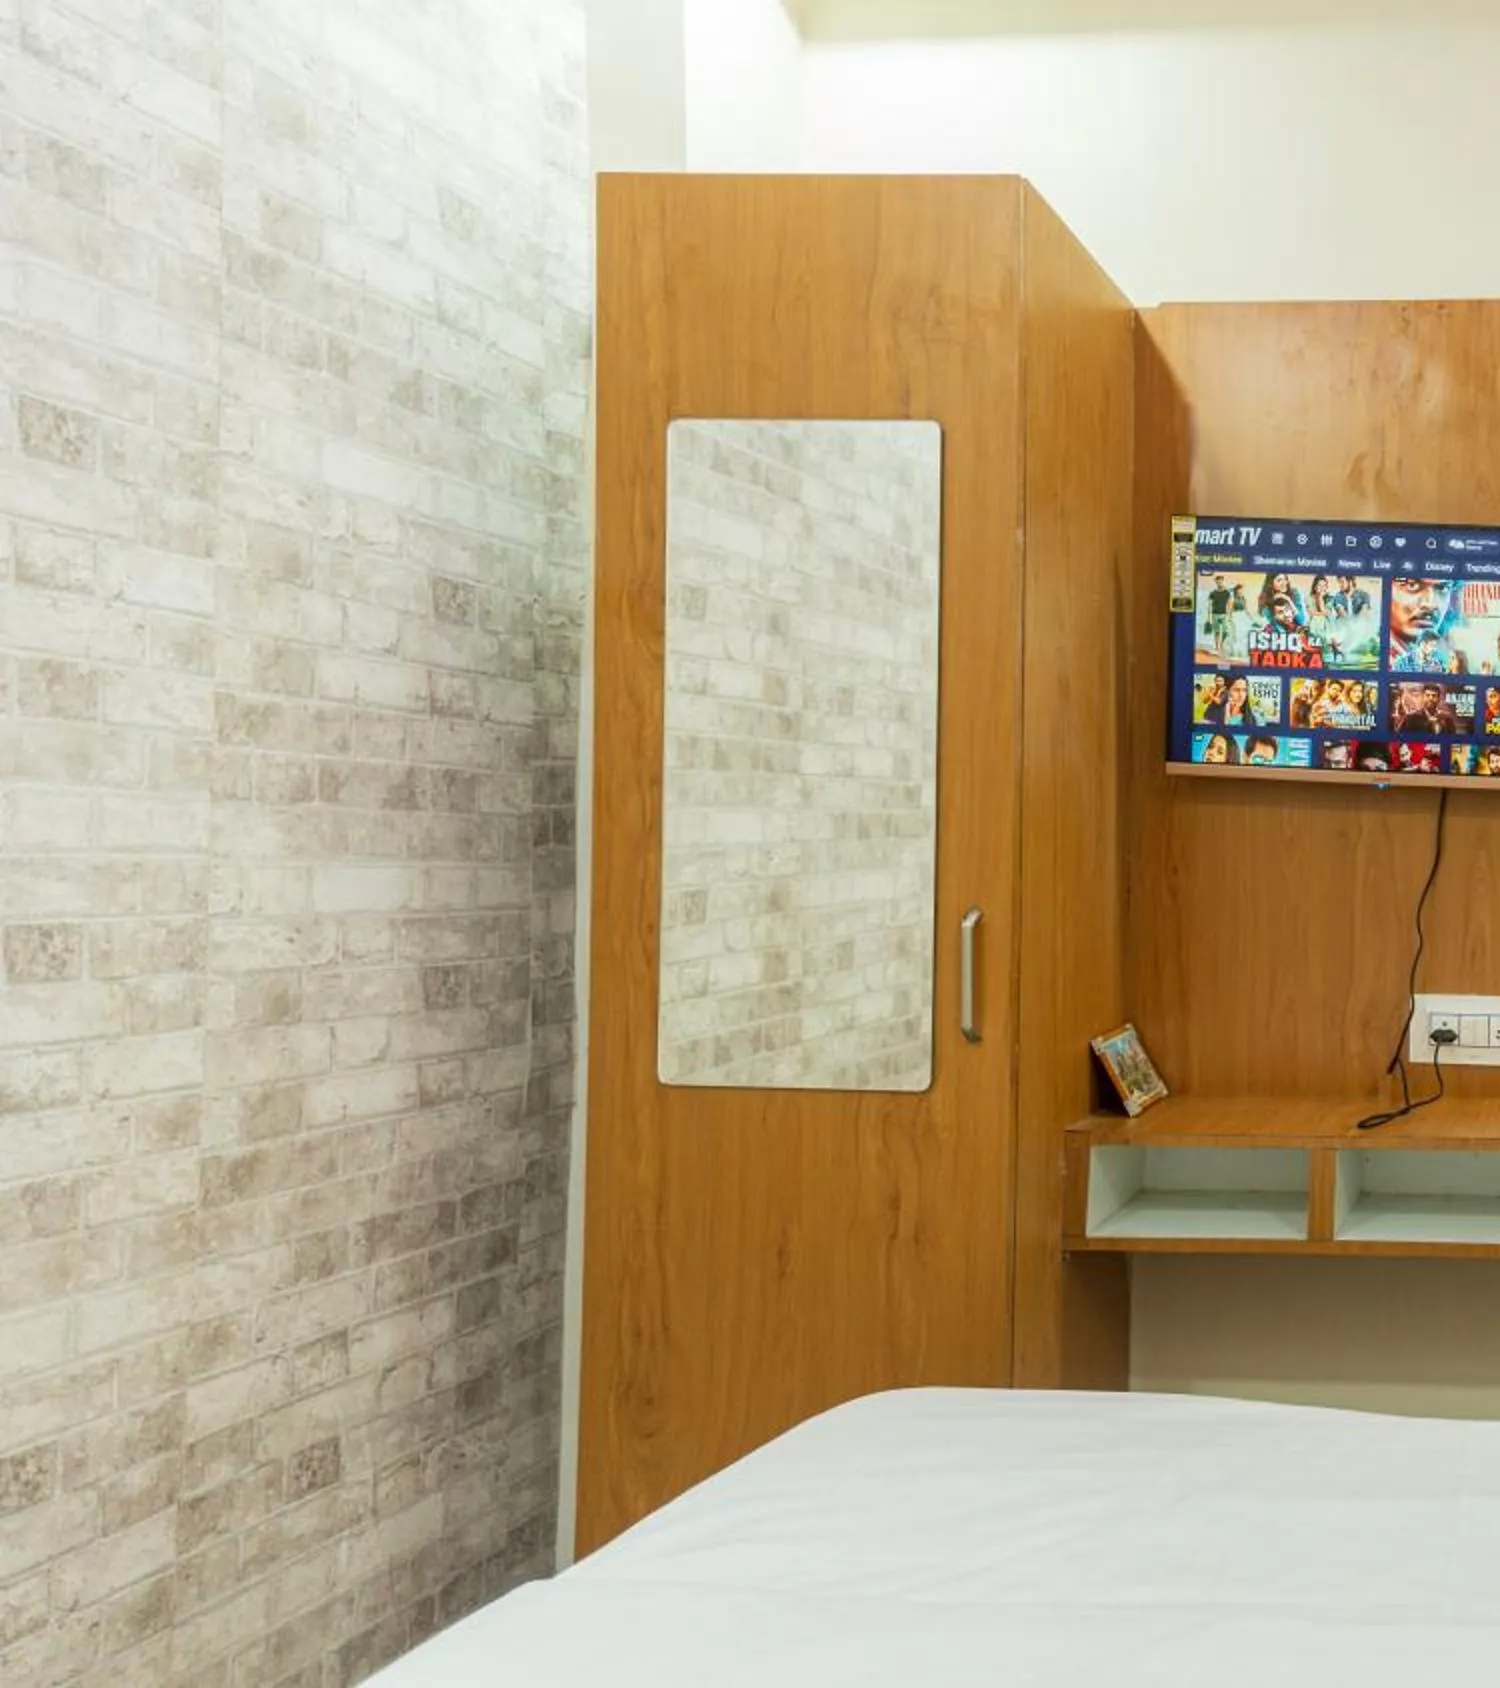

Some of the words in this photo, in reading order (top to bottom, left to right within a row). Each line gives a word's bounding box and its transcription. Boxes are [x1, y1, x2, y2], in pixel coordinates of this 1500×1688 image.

[1195, 527, 1235, 545] mart
[1239, 526, 1262, 546] TV
[1338, 559, 1362, 569] News
[1373, 560, 1392, 570] Live
[1249, 631, 1303, 652] ISHQ
[1250, 650, 1322, 669] TADKA
